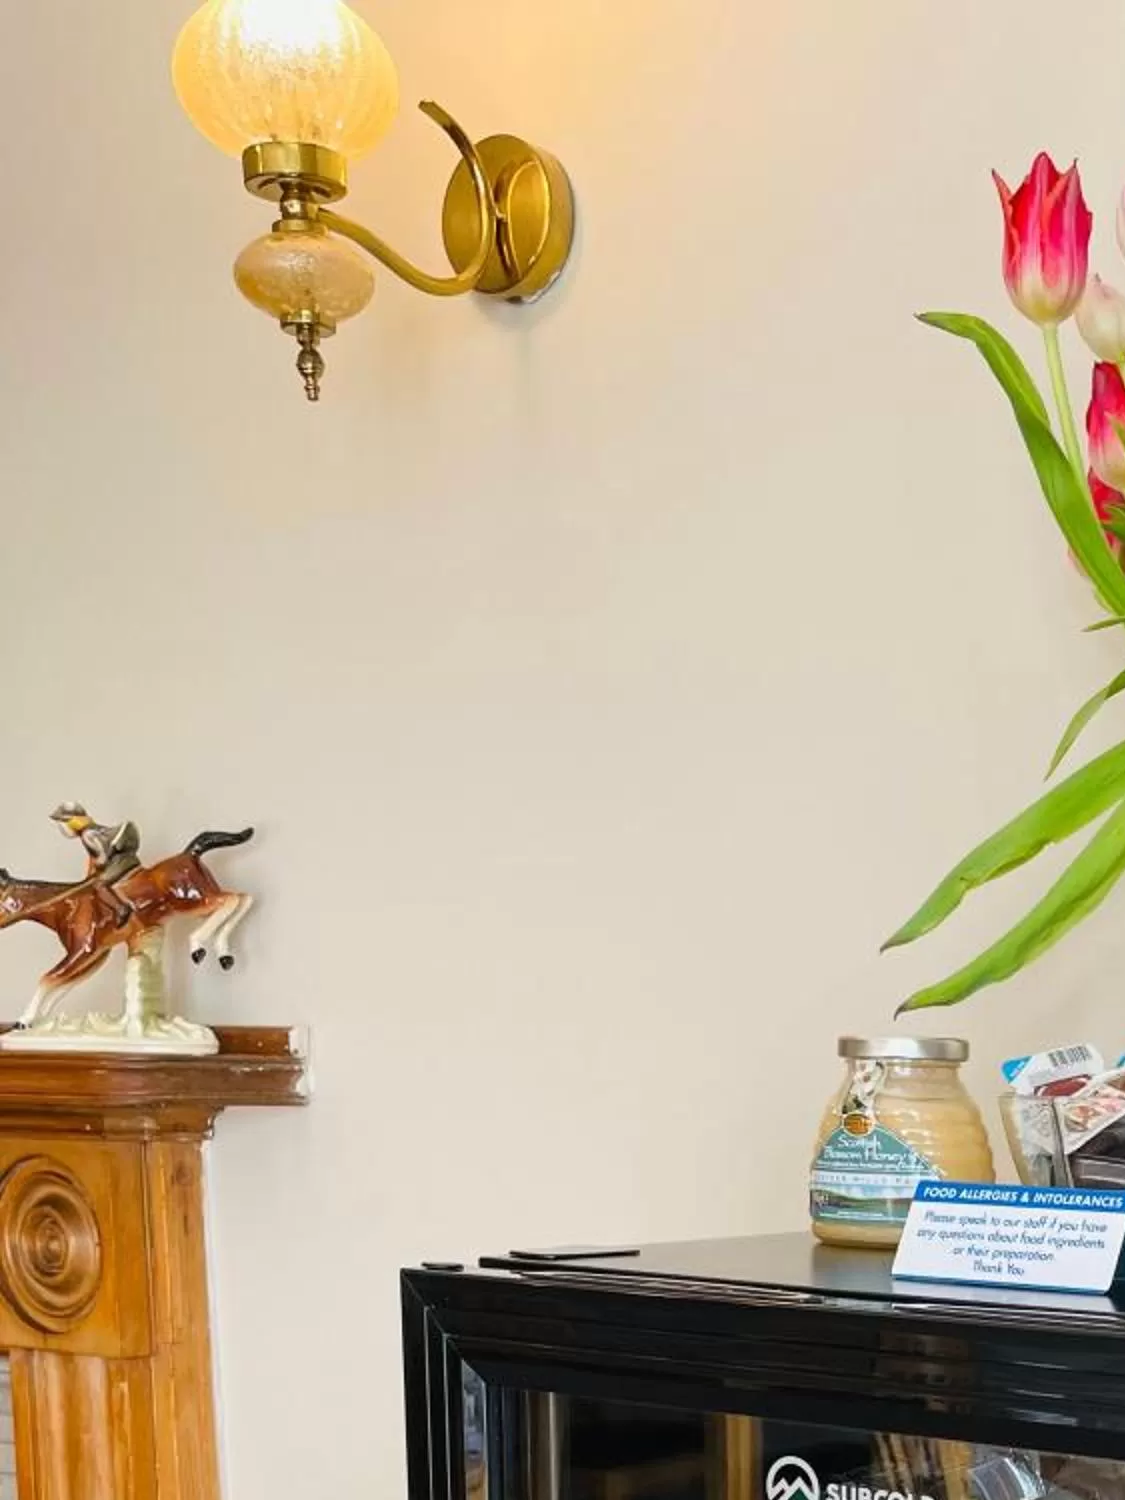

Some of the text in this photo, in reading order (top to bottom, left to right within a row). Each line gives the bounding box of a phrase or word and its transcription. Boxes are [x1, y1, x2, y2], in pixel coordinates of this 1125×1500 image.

[923, 1187, 1123, 1209] FOOD ALLERGIES & INTOLERANCES
[924, 1209, 1108, 1233] Please speak to our staff if you have
[916, 1229, 1105, 1250] any questions about food ingredients
[953, 1246, 965, 1256] or
[966, 1245, 990, 1257] their
[973, 1259, 1025, 1276] Thank You
